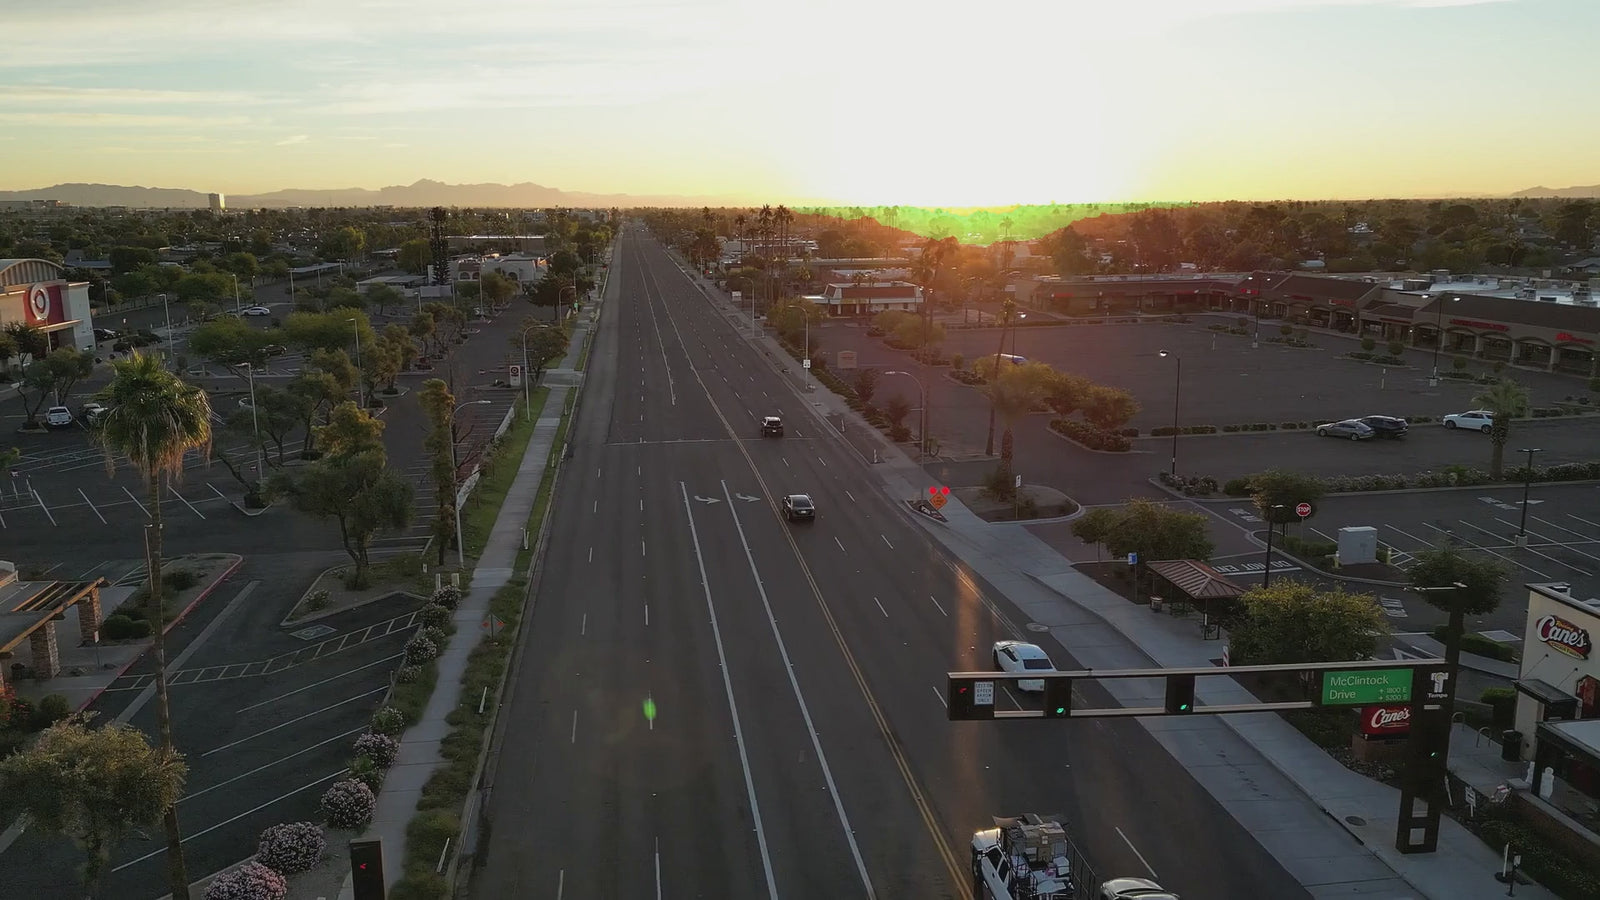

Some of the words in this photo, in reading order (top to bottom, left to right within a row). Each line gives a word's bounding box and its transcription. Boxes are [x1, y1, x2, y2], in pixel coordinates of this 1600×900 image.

[1537, 615, 1587, 647] Cane's
[1330, 675, 1389, 686] McClintock
[1329, 689, 1356, 700] Drive
[1371, 707, 1411, 728] Cane's
